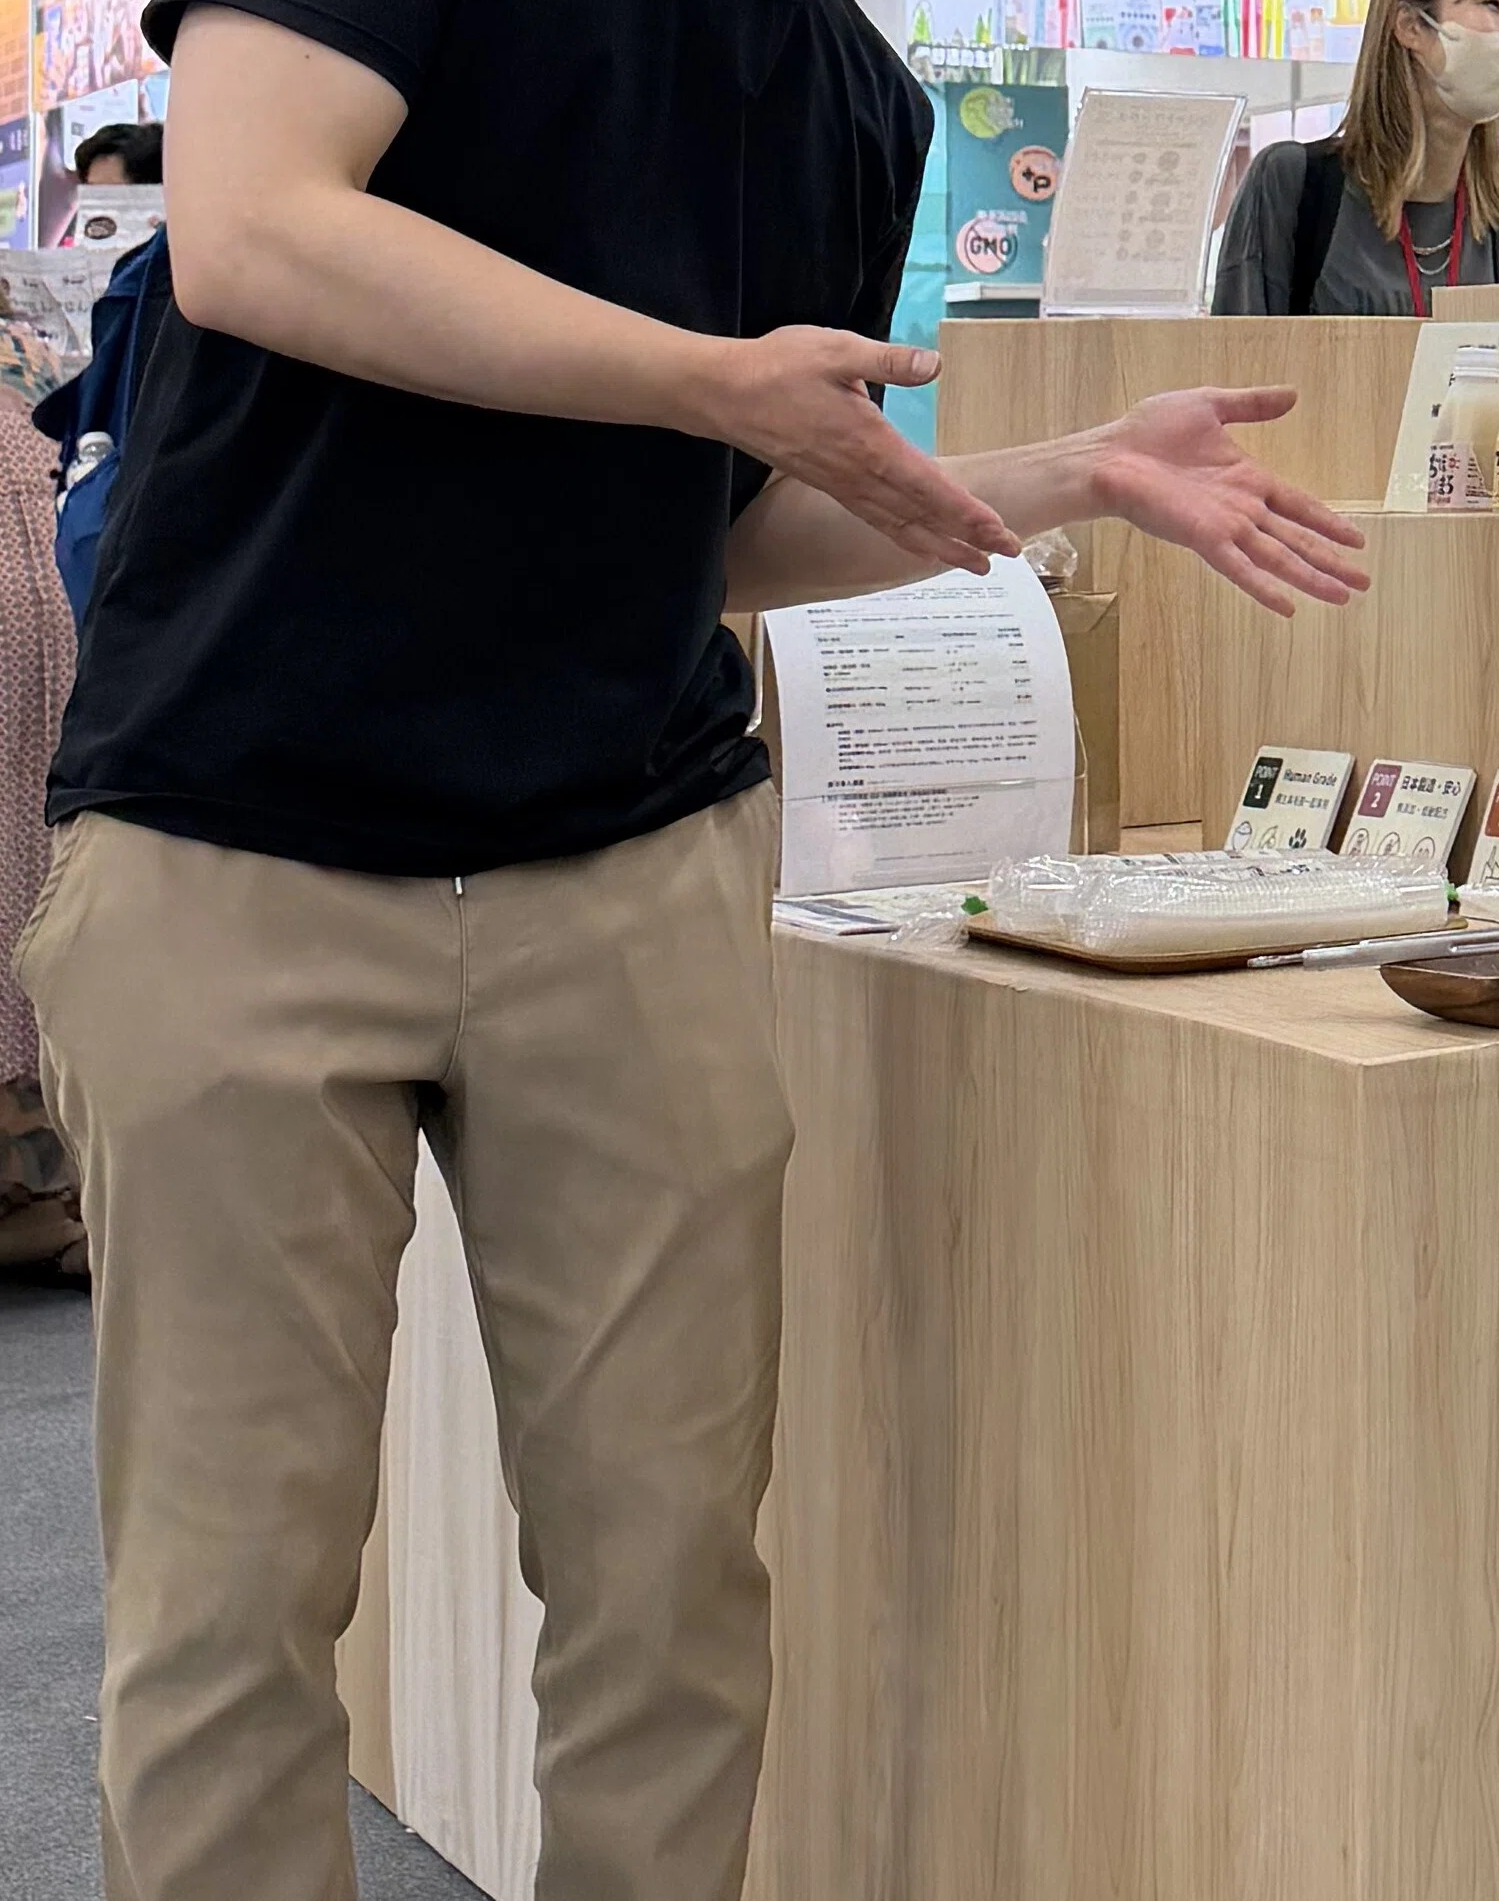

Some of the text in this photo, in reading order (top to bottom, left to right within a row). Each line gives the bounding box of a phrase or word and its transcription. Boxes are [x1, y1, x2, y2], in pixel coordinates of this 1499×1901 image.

[1254, 765, 1279, 779] POINT
[1282, 769, 1338, 787] Human Grade
[1371, 773, 1397, 787] POINT
[1254, 784, 1263, 800] 1
[1370, 792, 1381, 808] 2
